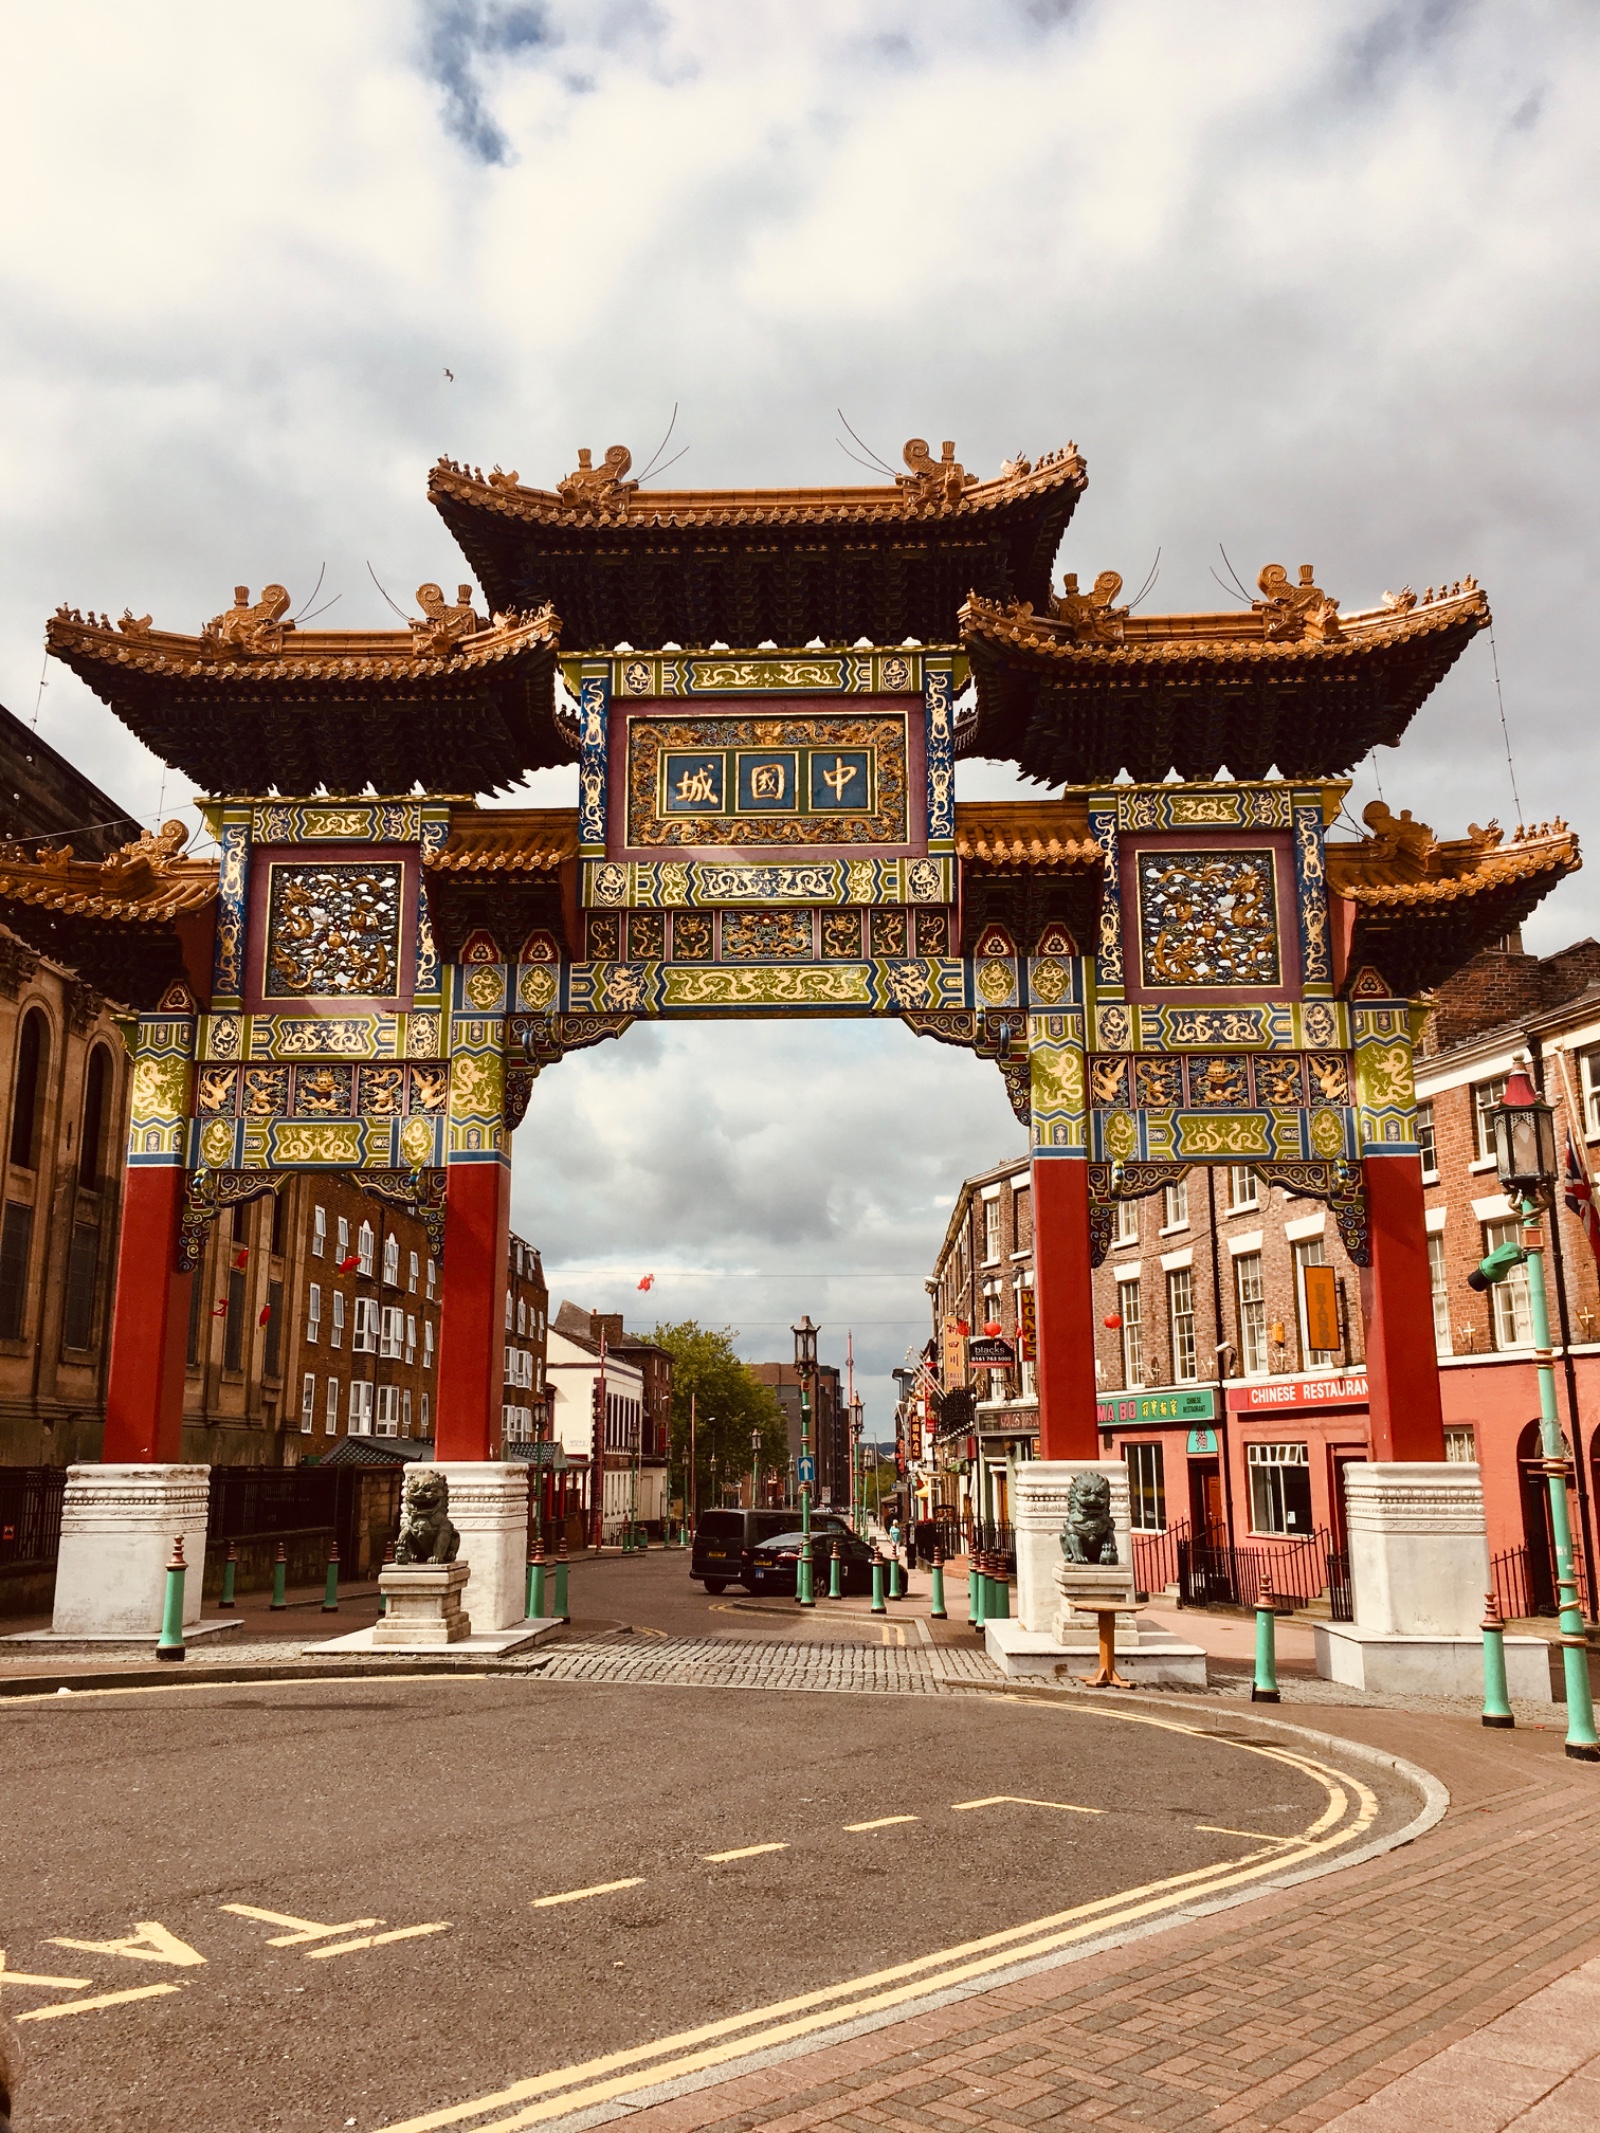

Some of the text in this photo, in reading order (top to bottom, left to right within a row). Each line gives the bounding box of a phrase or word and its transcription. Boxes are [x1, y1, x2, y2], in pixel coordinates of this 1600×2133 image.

[974, 1344, 1005, 1354] blacks
[1251, 1378, 1369, 1404] CHINESE RESTAURAN
[1186, 1396, 1202, 1405] CHINESE
[1096, 1400, 1137, 1422] MA BO
